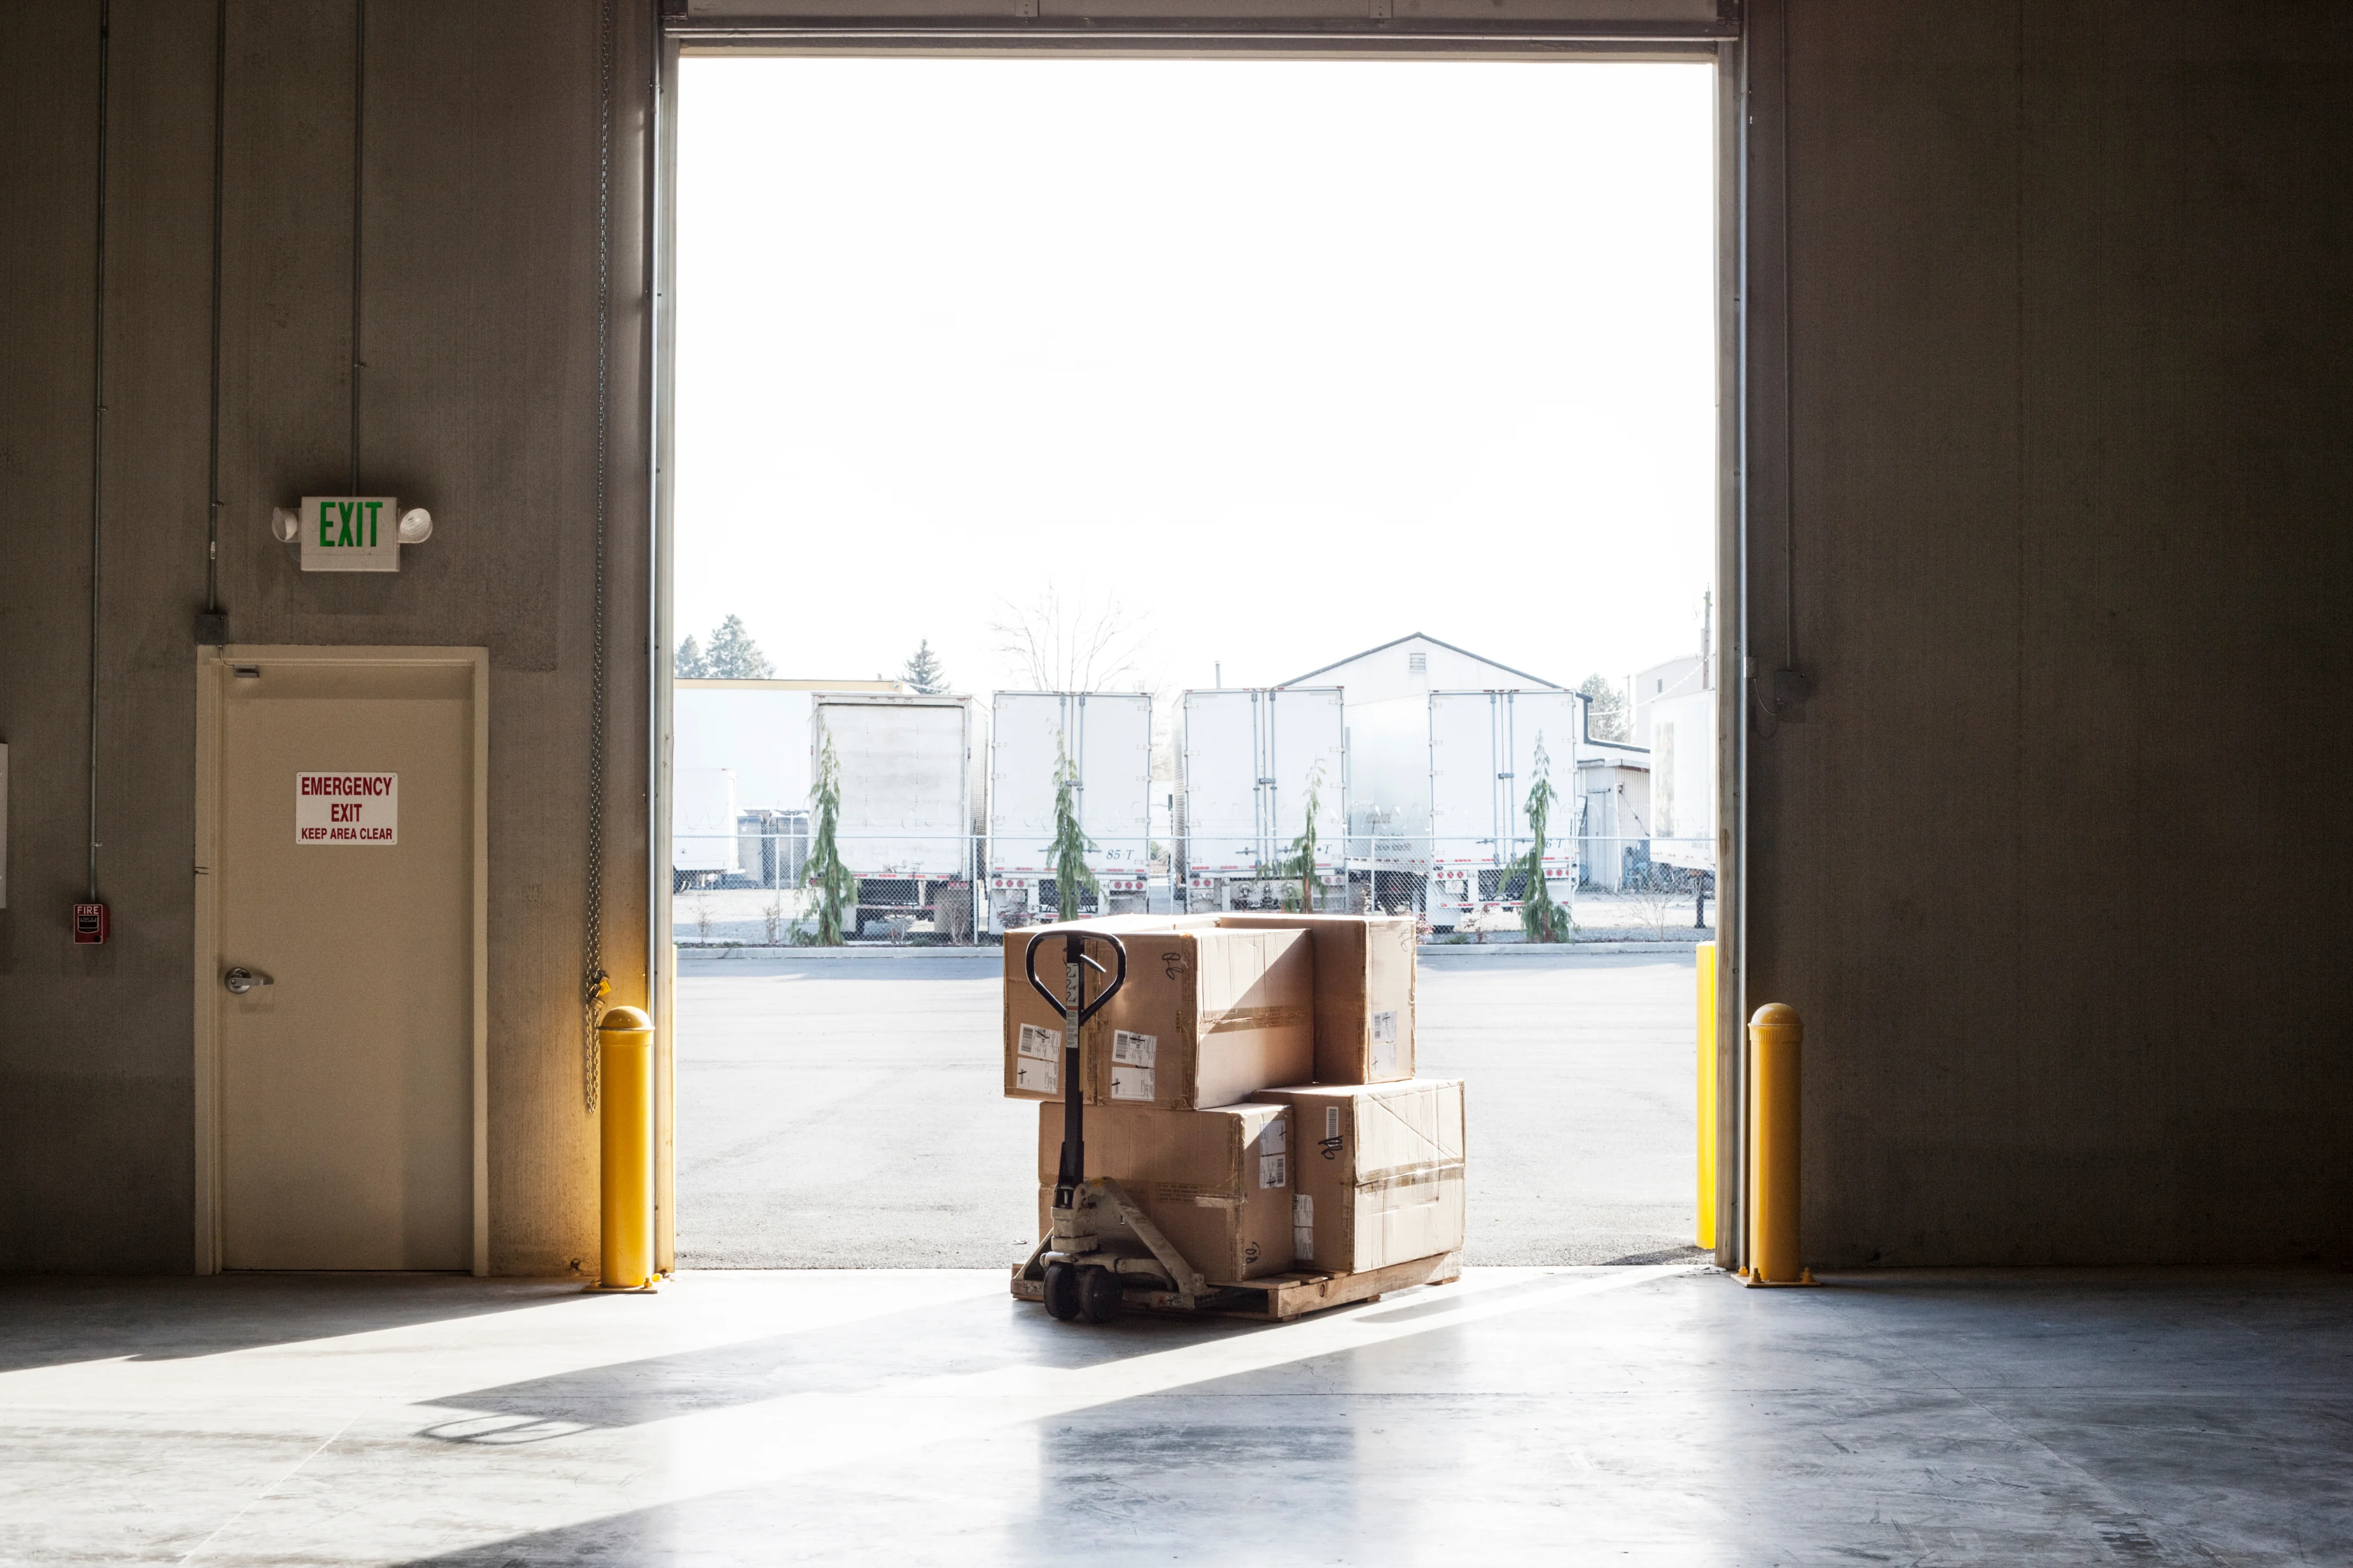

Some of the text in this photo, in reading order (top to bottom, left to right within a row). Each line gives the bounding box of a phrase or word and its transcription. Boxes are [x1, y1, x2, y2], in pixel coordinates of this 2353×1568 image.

[319, 501, 383, 547] EXIT
[302, 777, 392, 795] EMERGENCY
[331, 804, 362, 822] EXIT
[302, 828, 392, 840] KEEP AREA CLEAR
[77, 906, 99, 914] FIRE
